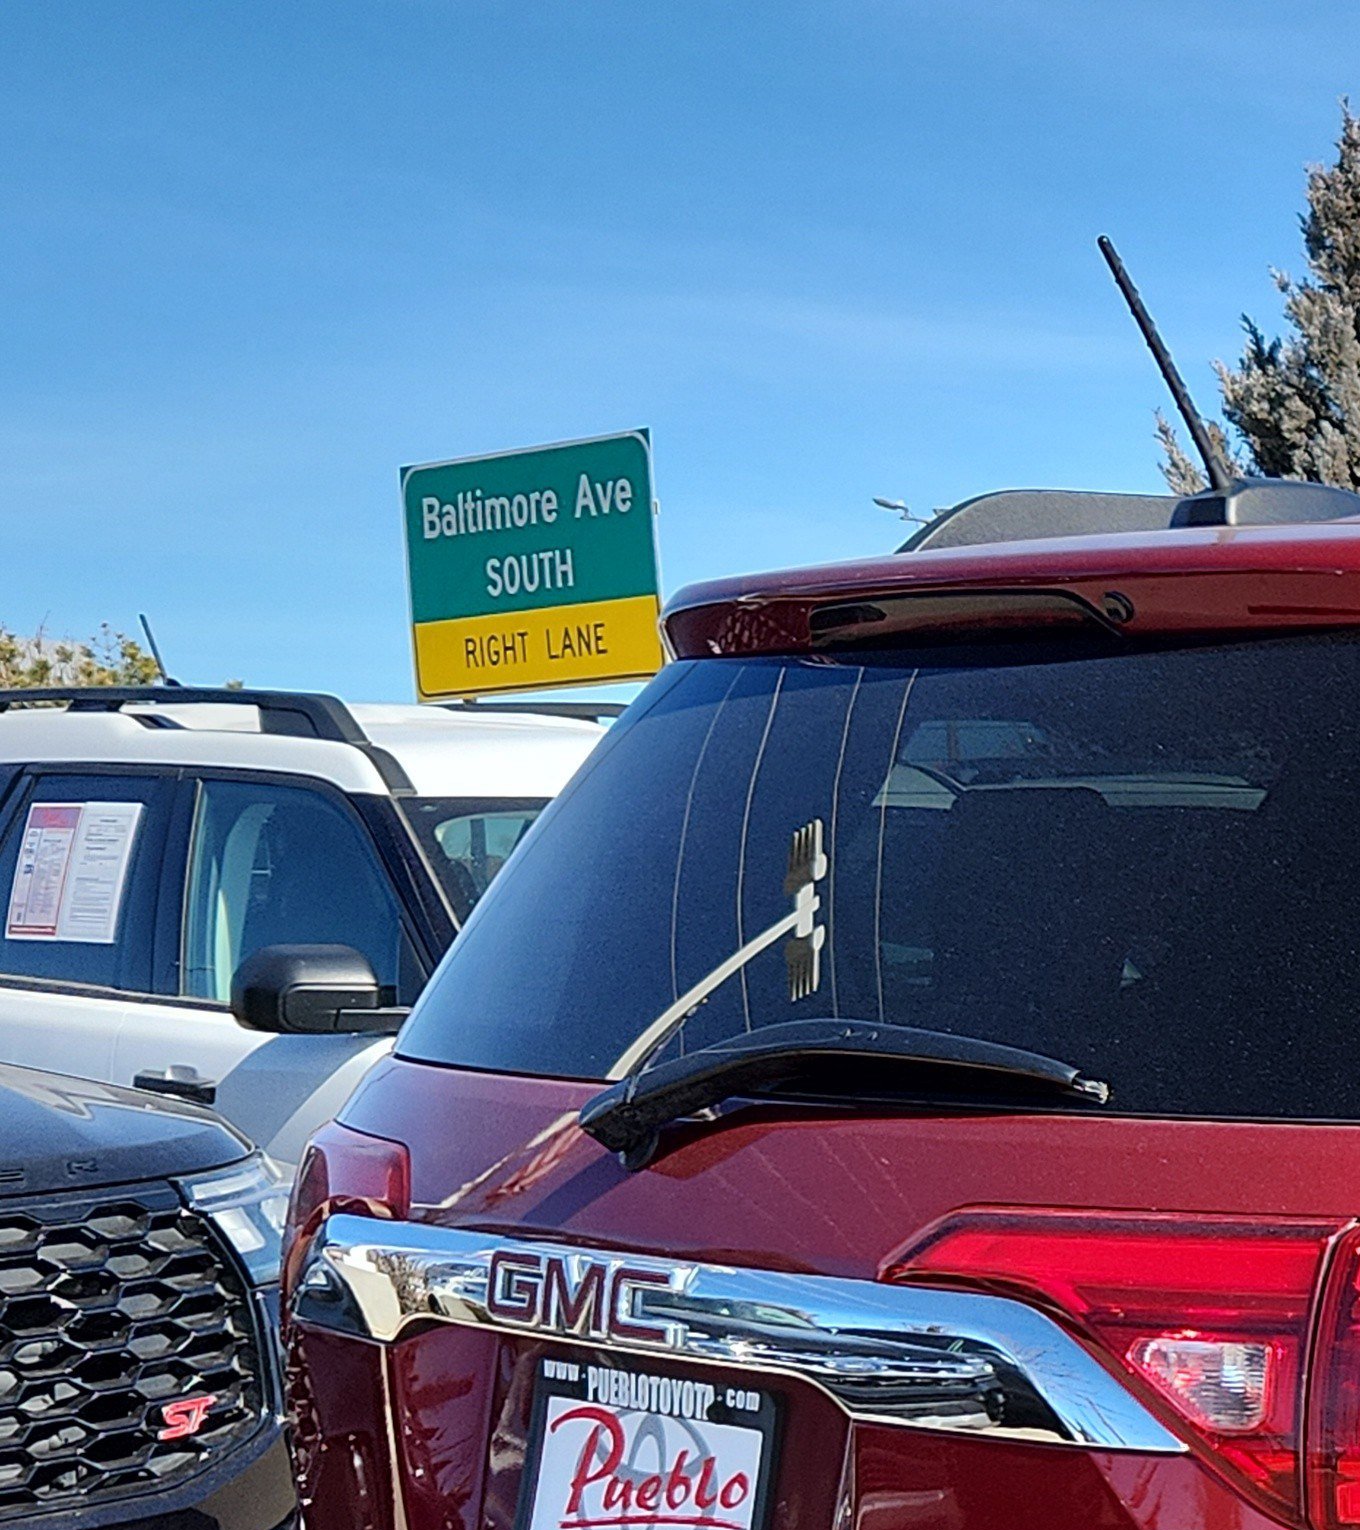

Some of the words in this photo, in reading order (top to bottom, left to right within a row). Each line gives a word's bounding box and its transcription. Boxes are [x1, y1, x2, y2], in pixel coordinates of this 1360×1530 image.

[421, 488, 558, 540] Baltimore
[574, 473, 633, 519] Ave
[485, 549, 575, 597] SOUTH
[464, 631, 529, 669] RIGHT
[545, 622, 609, 660] LANE
[486, 1249, 688, 1350] GMC
[157, 1395, 218, 1441] ST
[550, 1406, 750, 1516] Pueblo
